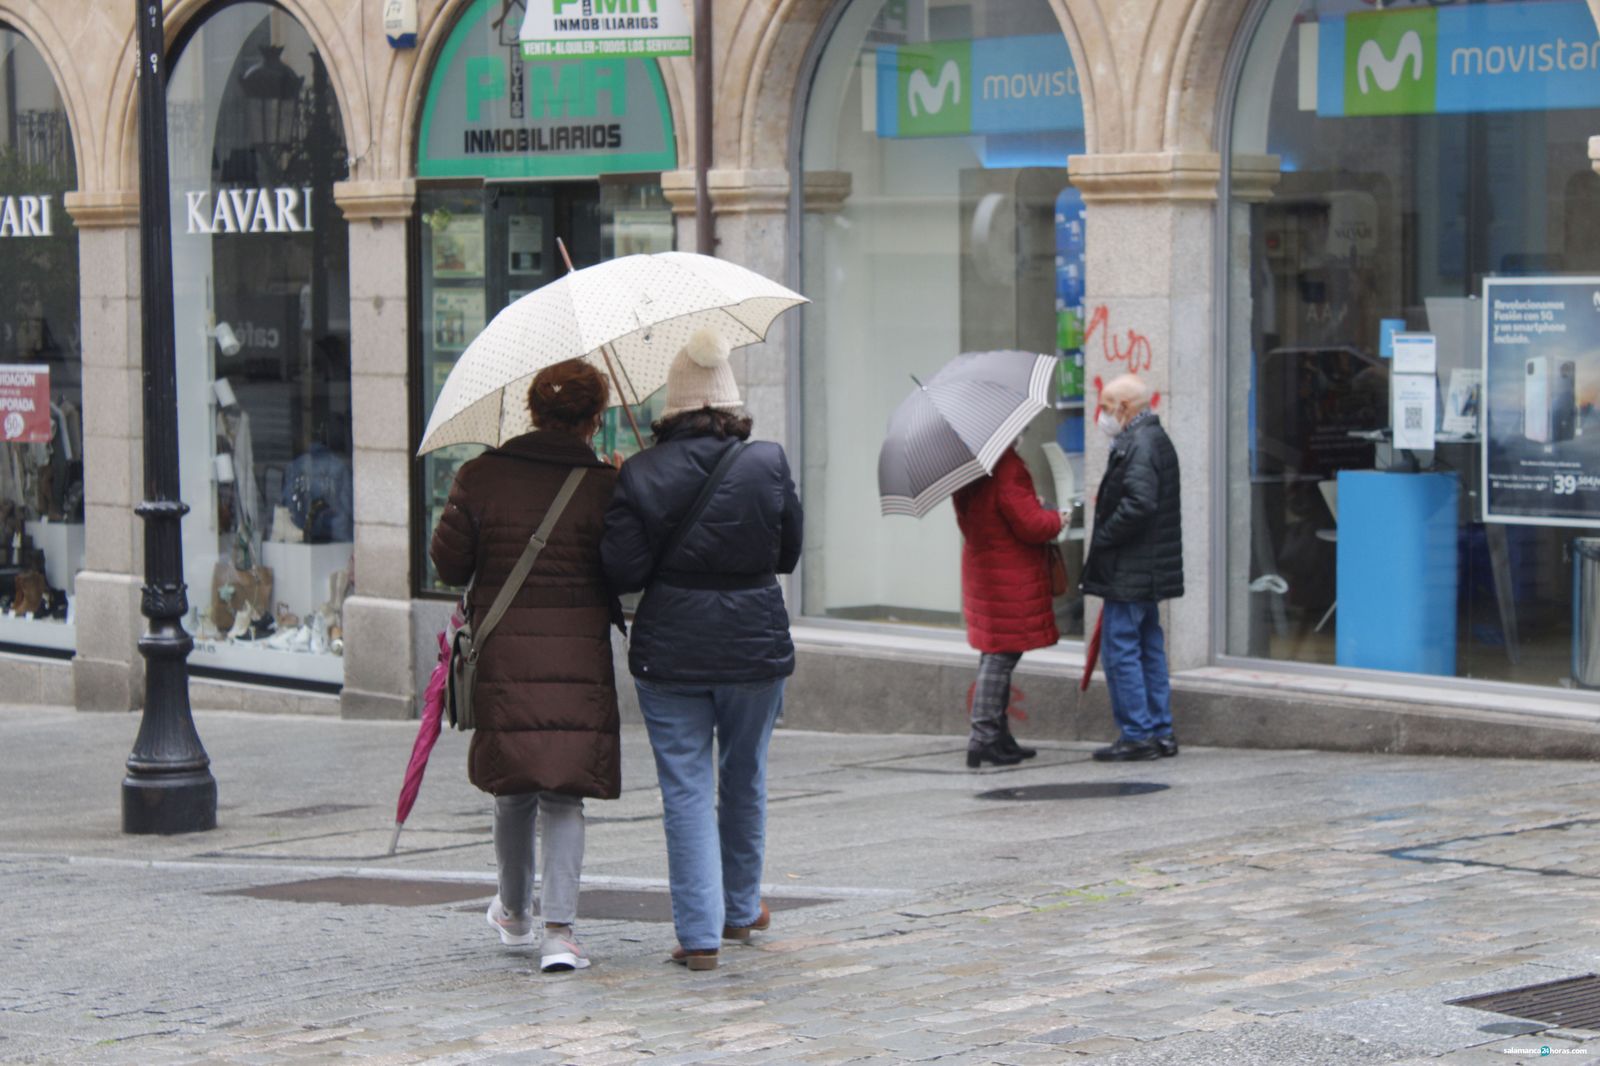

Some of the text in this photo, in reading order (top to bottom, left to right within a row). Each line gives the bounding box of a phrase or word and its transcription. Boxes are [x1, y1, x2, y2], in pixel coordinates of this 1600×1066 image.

[628, 40, 645, 51] LOS
[646, 39, 690, 51] SERVICIOS
[1451, 38, 1600, 76] movistar
[983, 66, 1080, 99] movist
[464, 124, 620, 153] INMOBILIARIOS
[0, 194, 53, 237] ARI
[186, 187, 313, 234] KAVARI
[1554, 474, 1576, 495] 39
